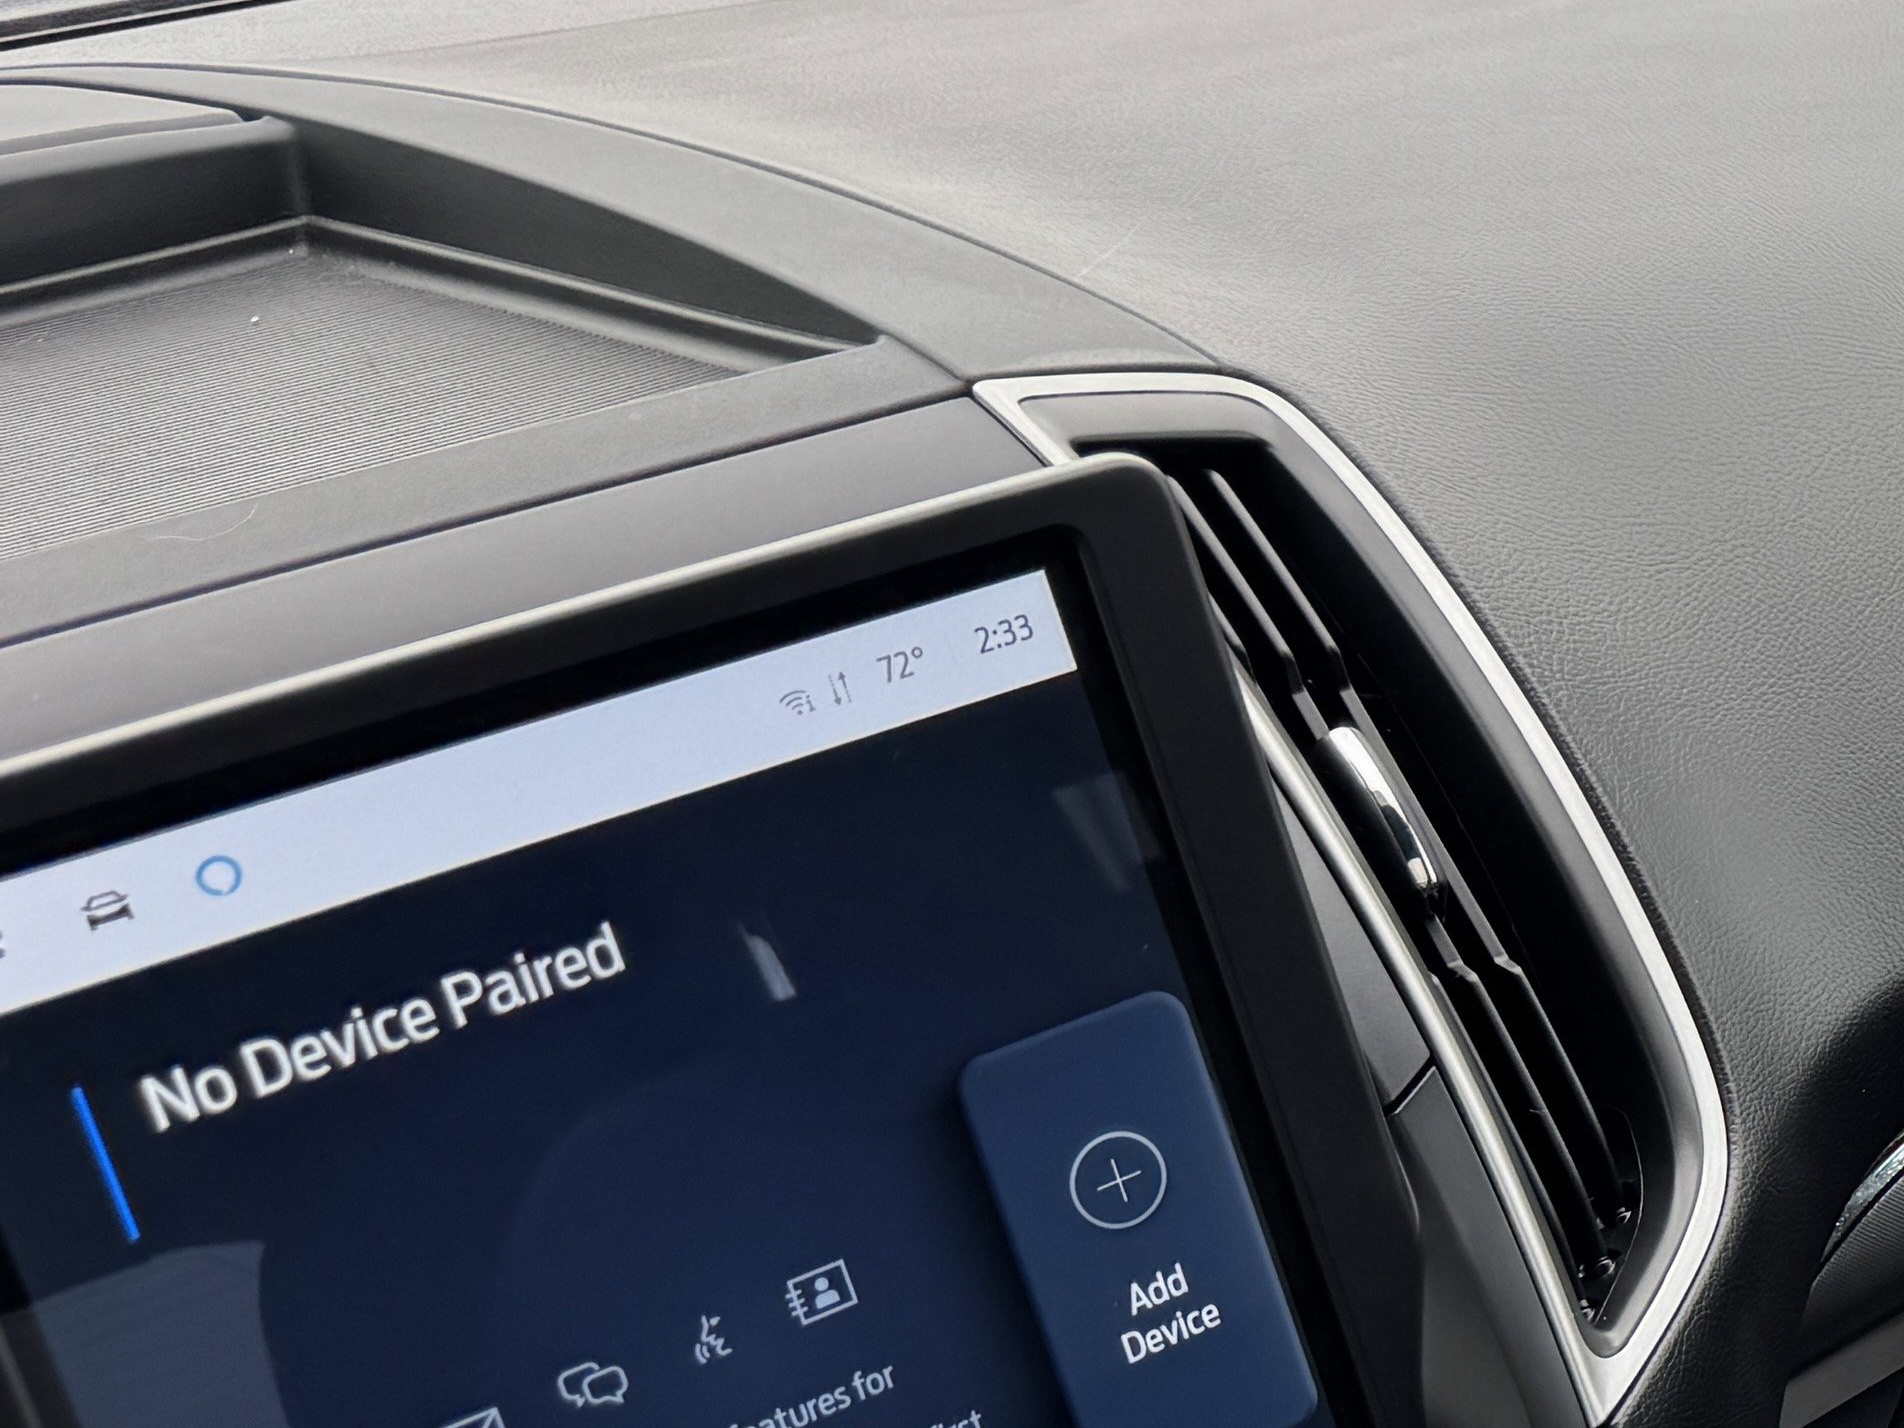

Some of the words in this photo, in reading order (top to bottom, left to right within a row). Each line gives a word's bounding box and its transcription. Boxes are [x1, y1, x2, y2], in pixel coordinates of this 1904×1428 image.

[973, 613, 1035, 657] 2:33
[138, 1062, 237, 1133] No
[240, 994, 440, 1104] Device
[439, 921, 627, 1029] Paired
[1129, 1262, 1189, 1316] Add
[1120, 1303, 1222, 1364] Device
[851, 1366, 895, 1400] for
